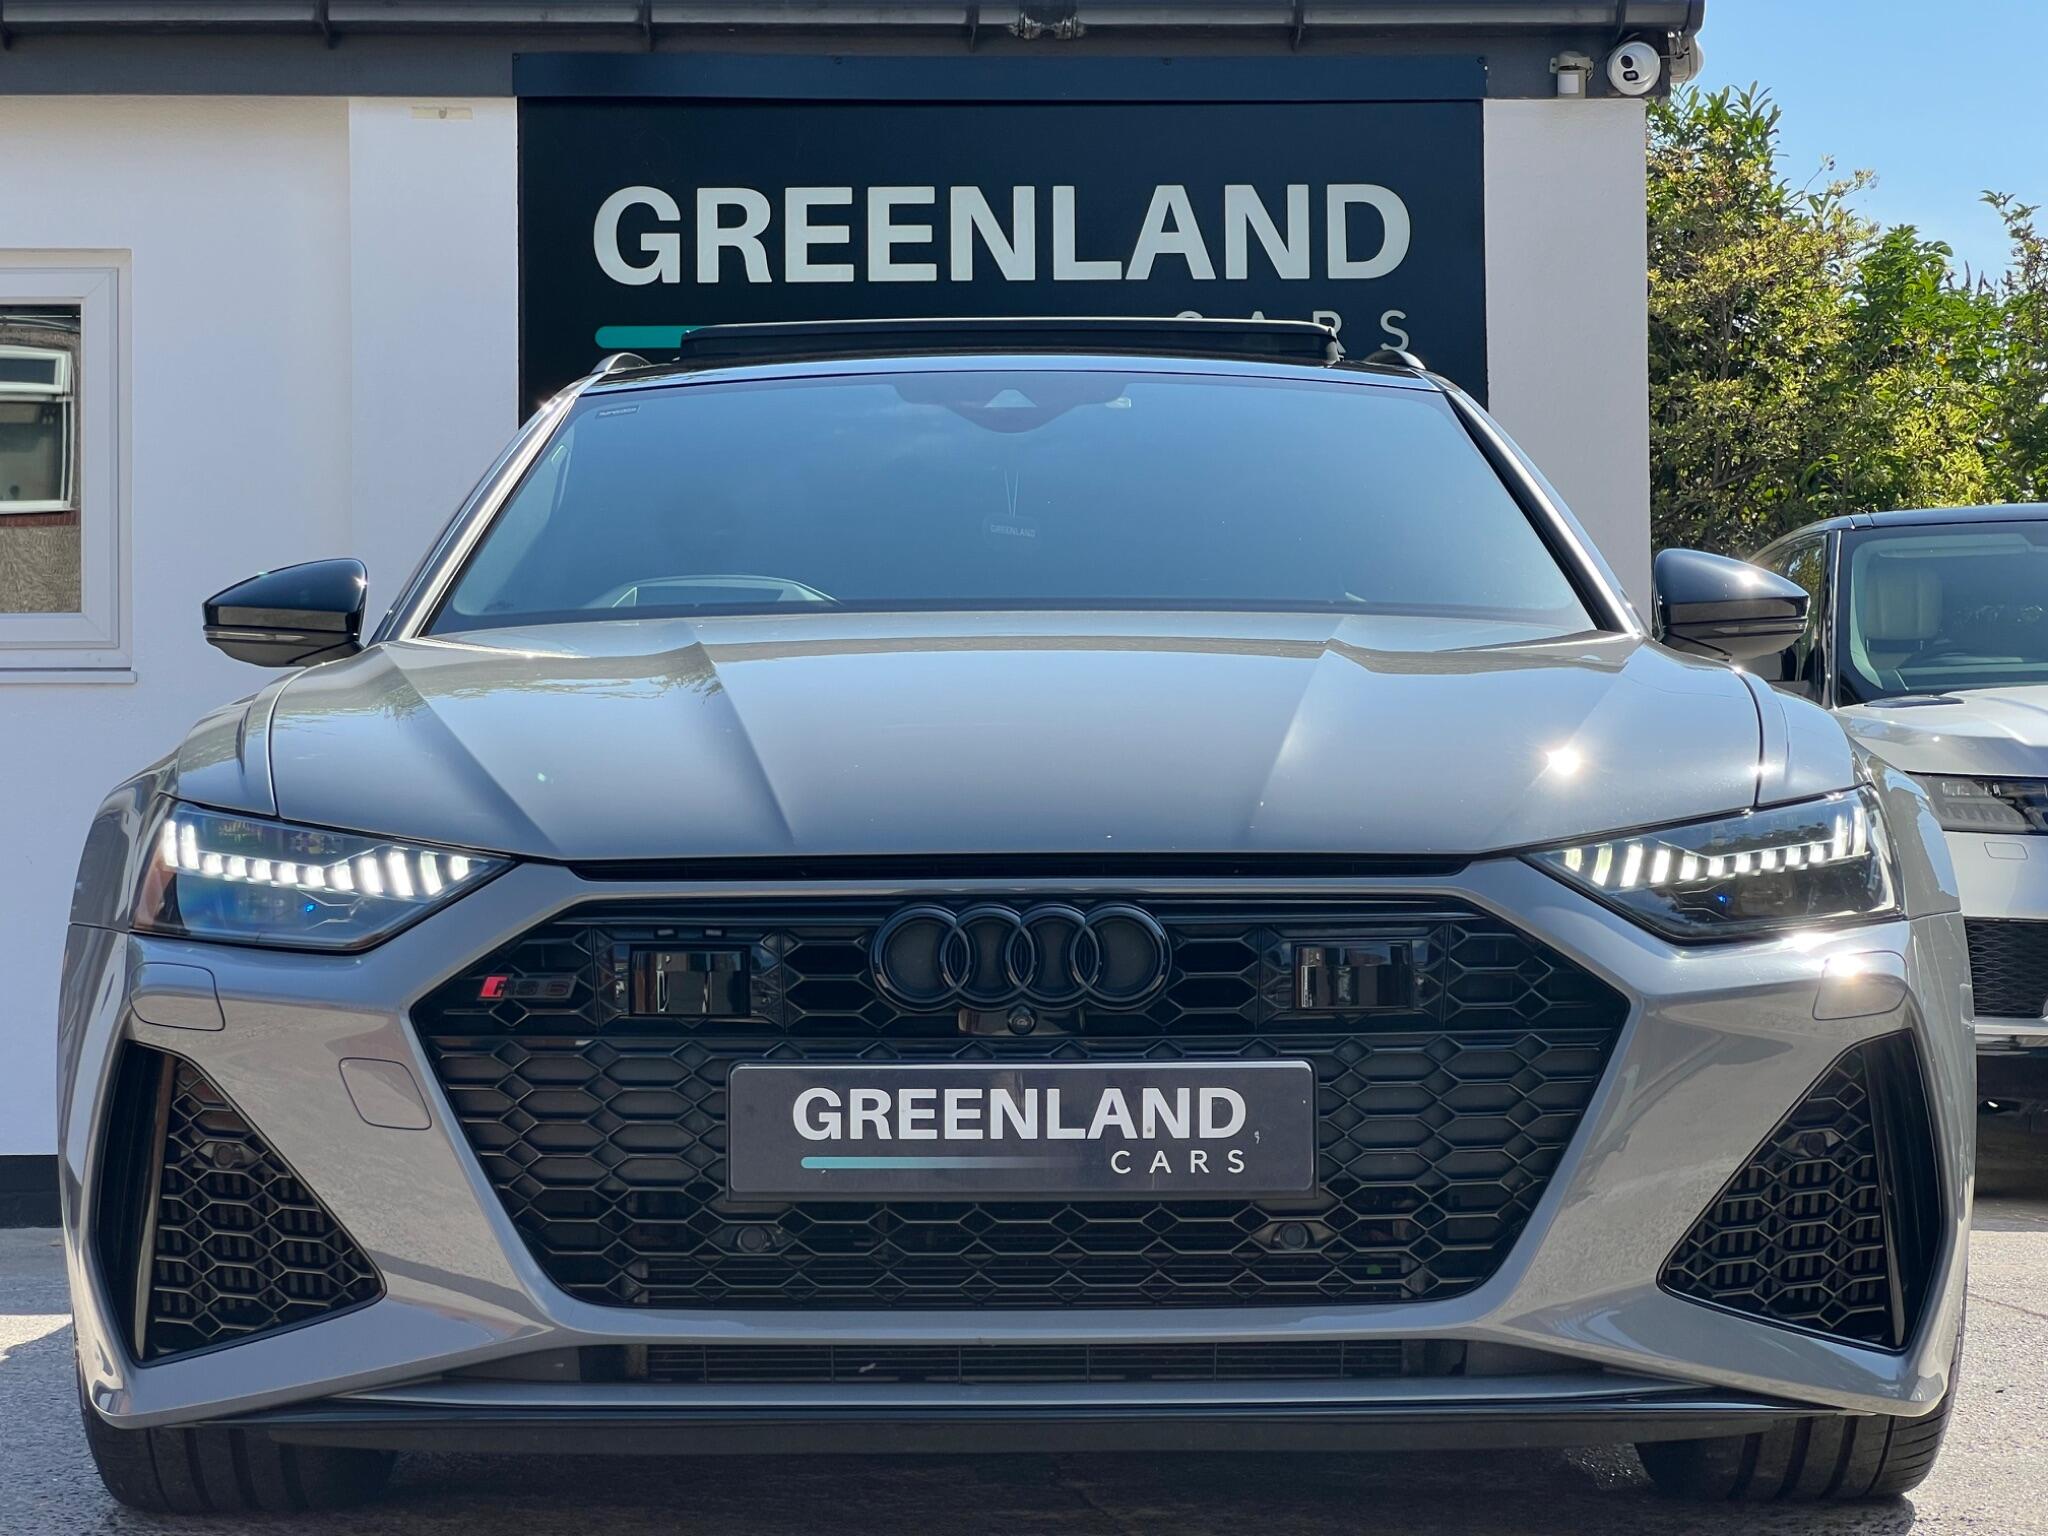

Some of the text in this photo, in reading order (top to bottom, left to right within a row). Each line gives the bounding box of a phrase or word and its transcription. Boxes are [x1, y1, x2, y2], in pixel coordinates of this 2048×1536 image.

[594, 184, 1411, 286] GREENLAND
[1173, 310, 1410, 353] RS
[793, 1087, 1246, 1141] GREENLAND
[1110, 1150, 1245, 1174] CARS
